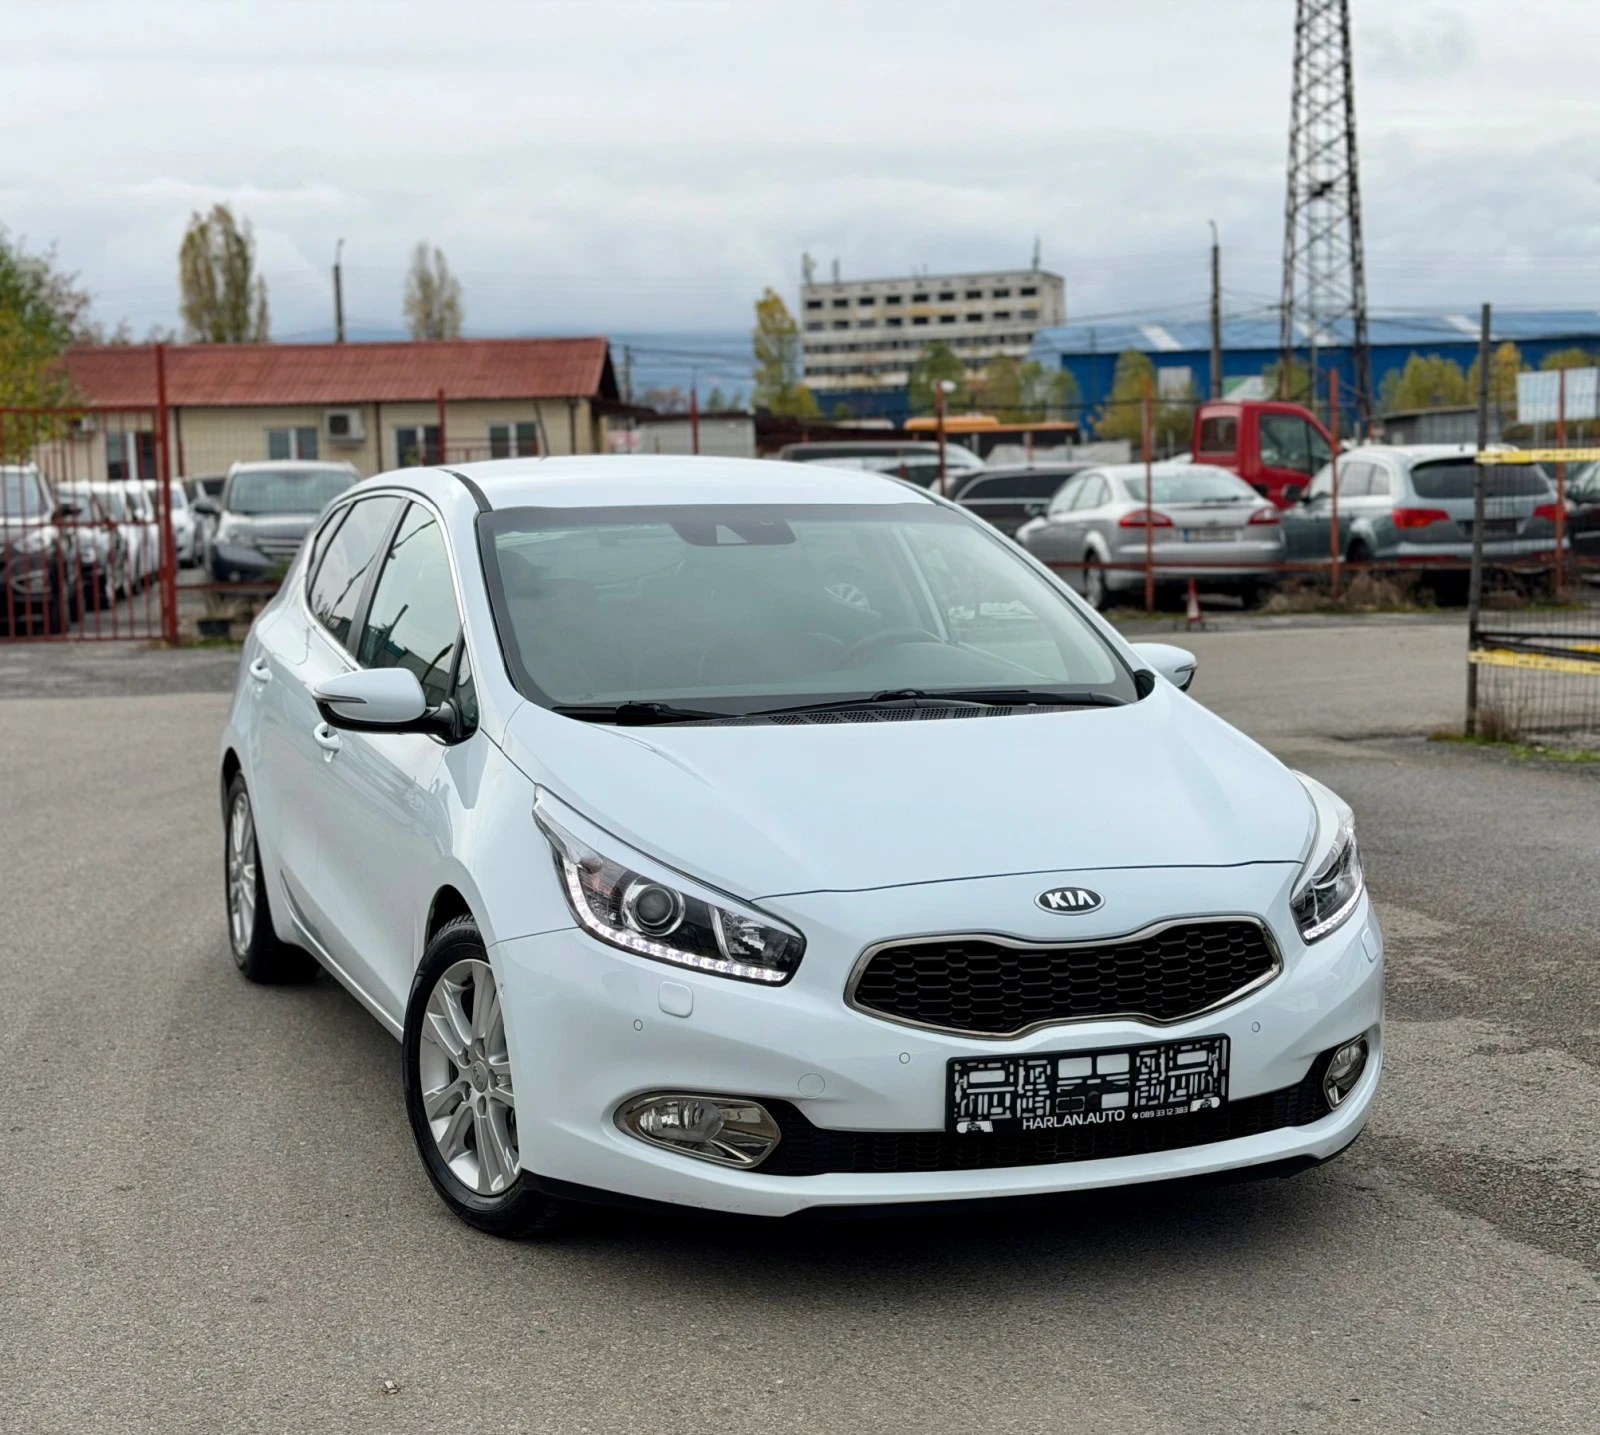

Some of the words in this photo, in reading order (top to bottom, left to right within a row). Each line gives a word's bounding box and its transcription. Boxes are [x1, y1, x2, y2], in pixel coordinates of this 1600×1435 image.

[1045, 890, 1096, 908] KIA
[1022, 1109, 1126, 1130] HARLAN.AUTO
[1140, 1111, 1155, 1119] 089
[1155, 1109, 1165, 1117] 33
